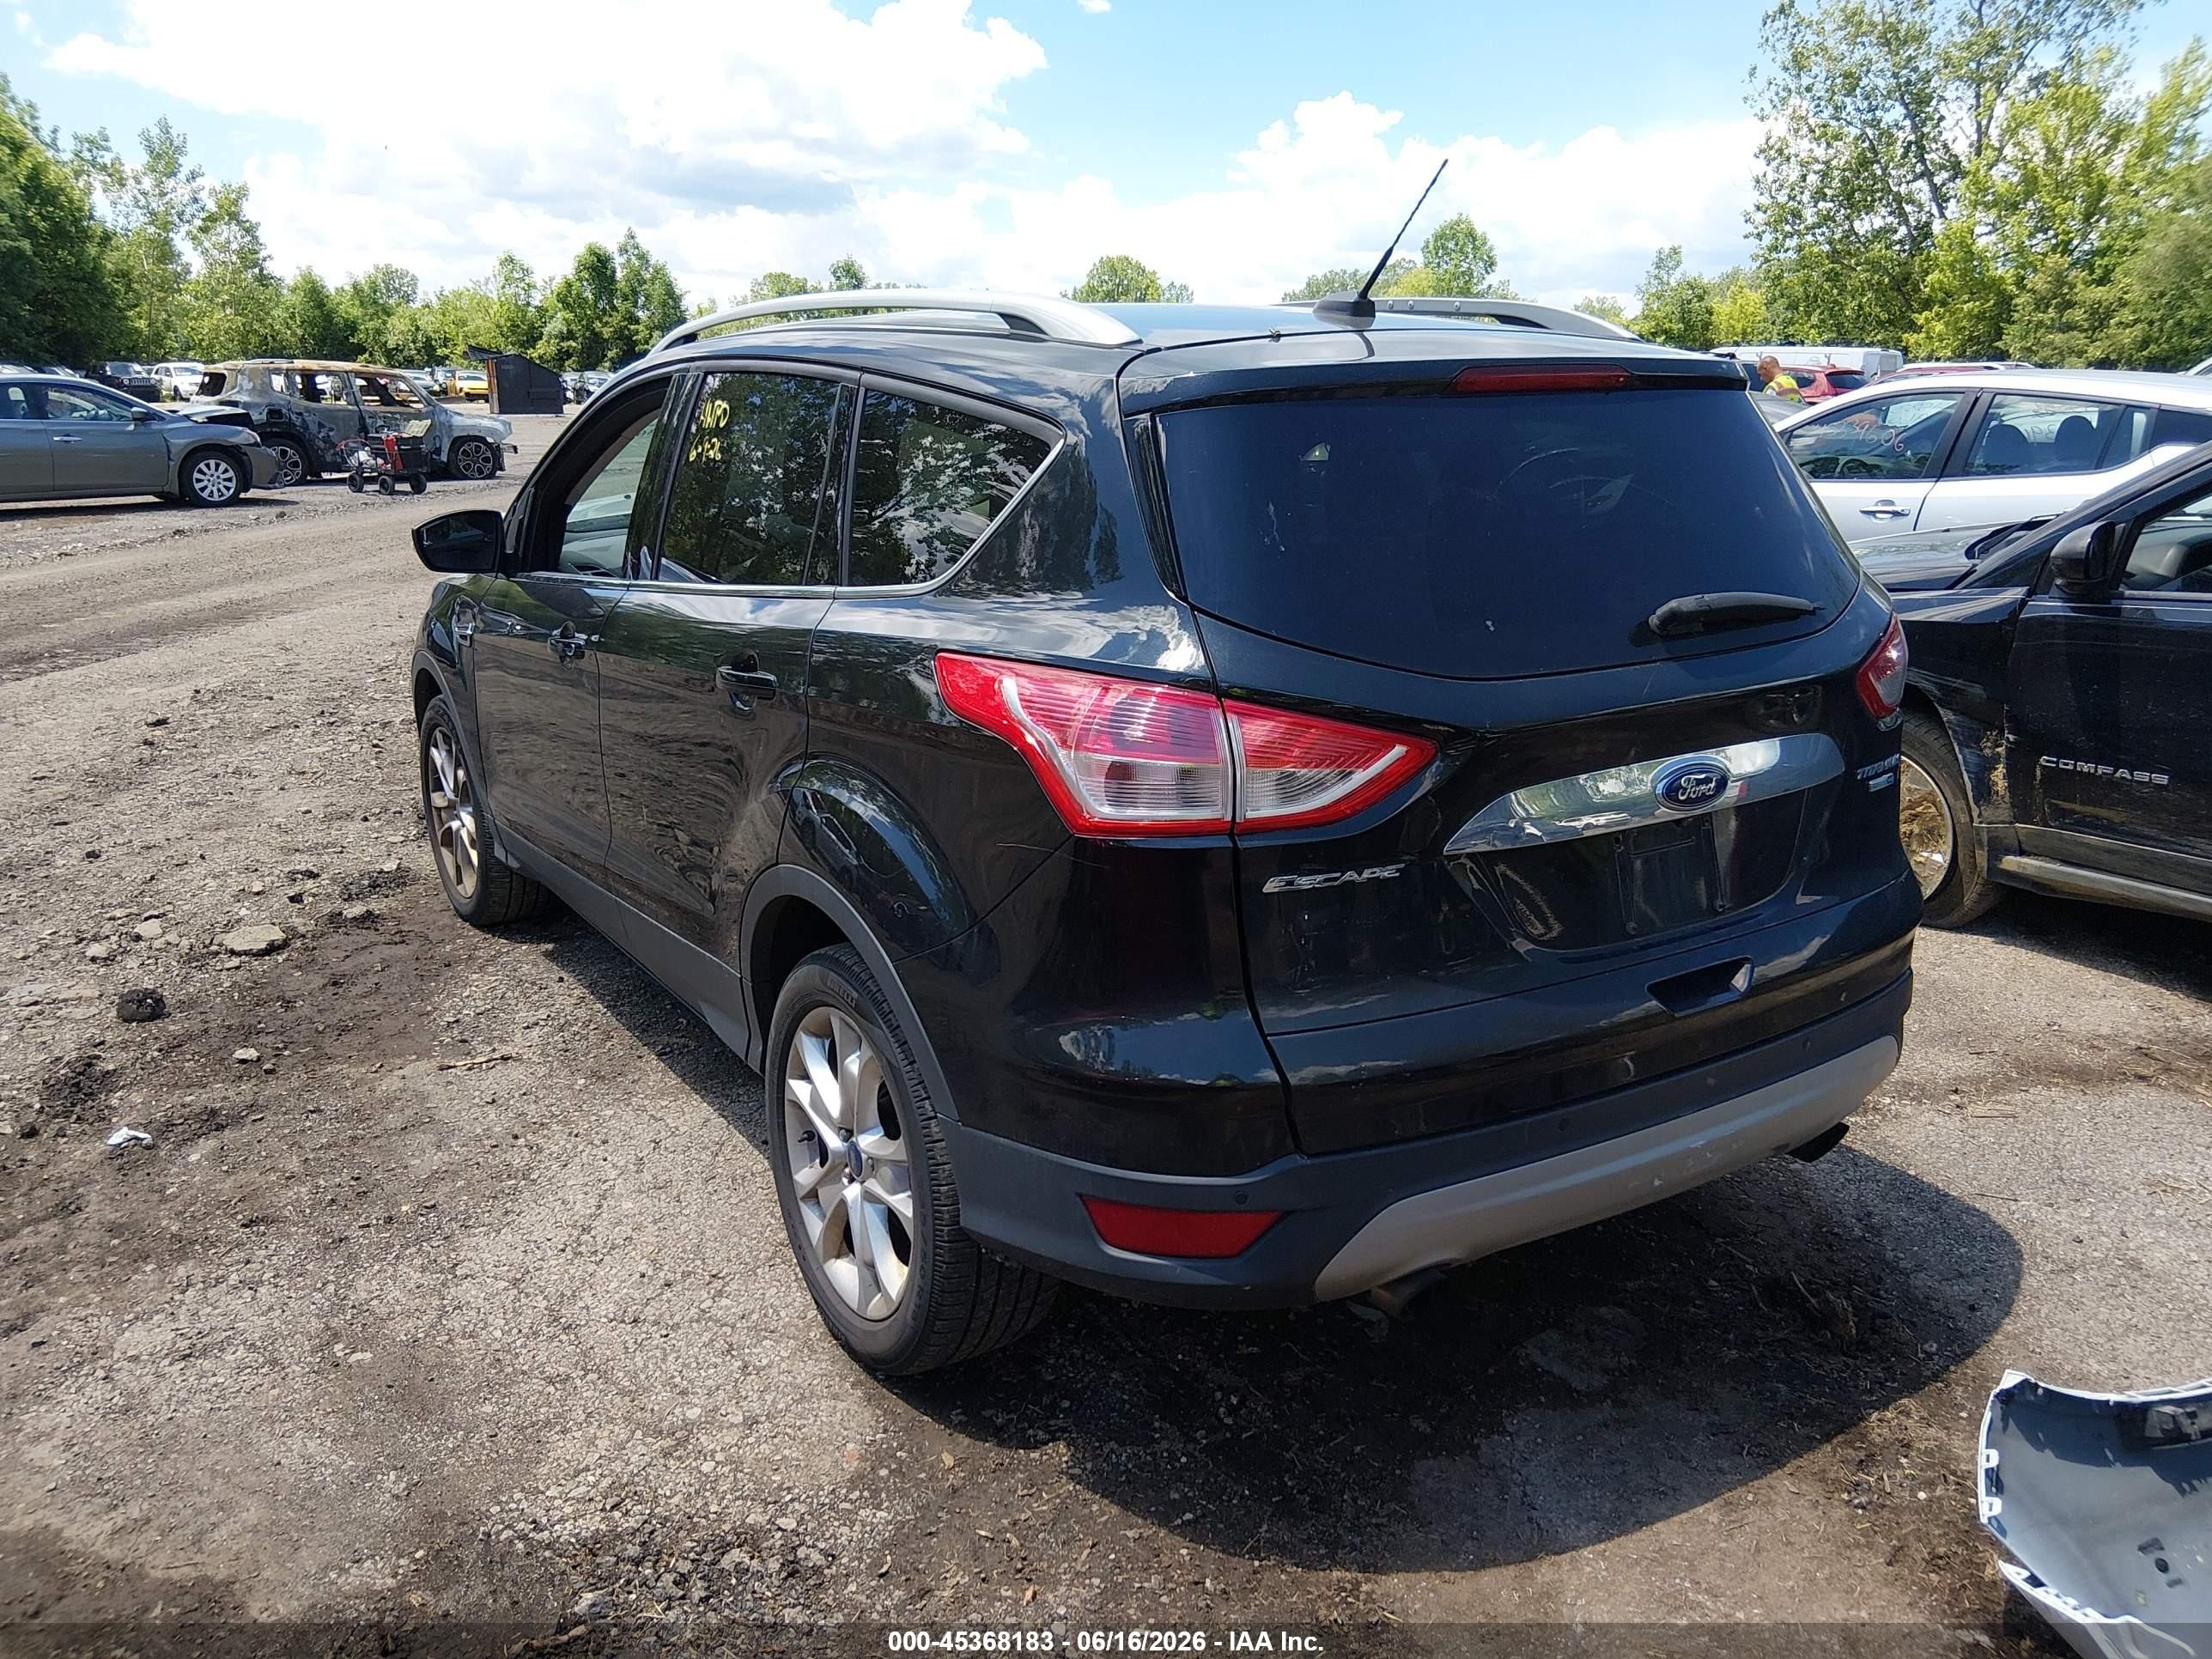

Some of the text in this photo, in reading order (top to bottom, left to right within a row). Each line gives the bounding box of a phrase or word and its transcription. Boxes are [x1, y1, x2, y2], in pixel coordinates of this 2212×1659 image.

[2040, 756, 2169, 785] COMPASS
[1678, 773, 1721, 800] Ford
[1262, 863, 1406, 893] ESCAPE
